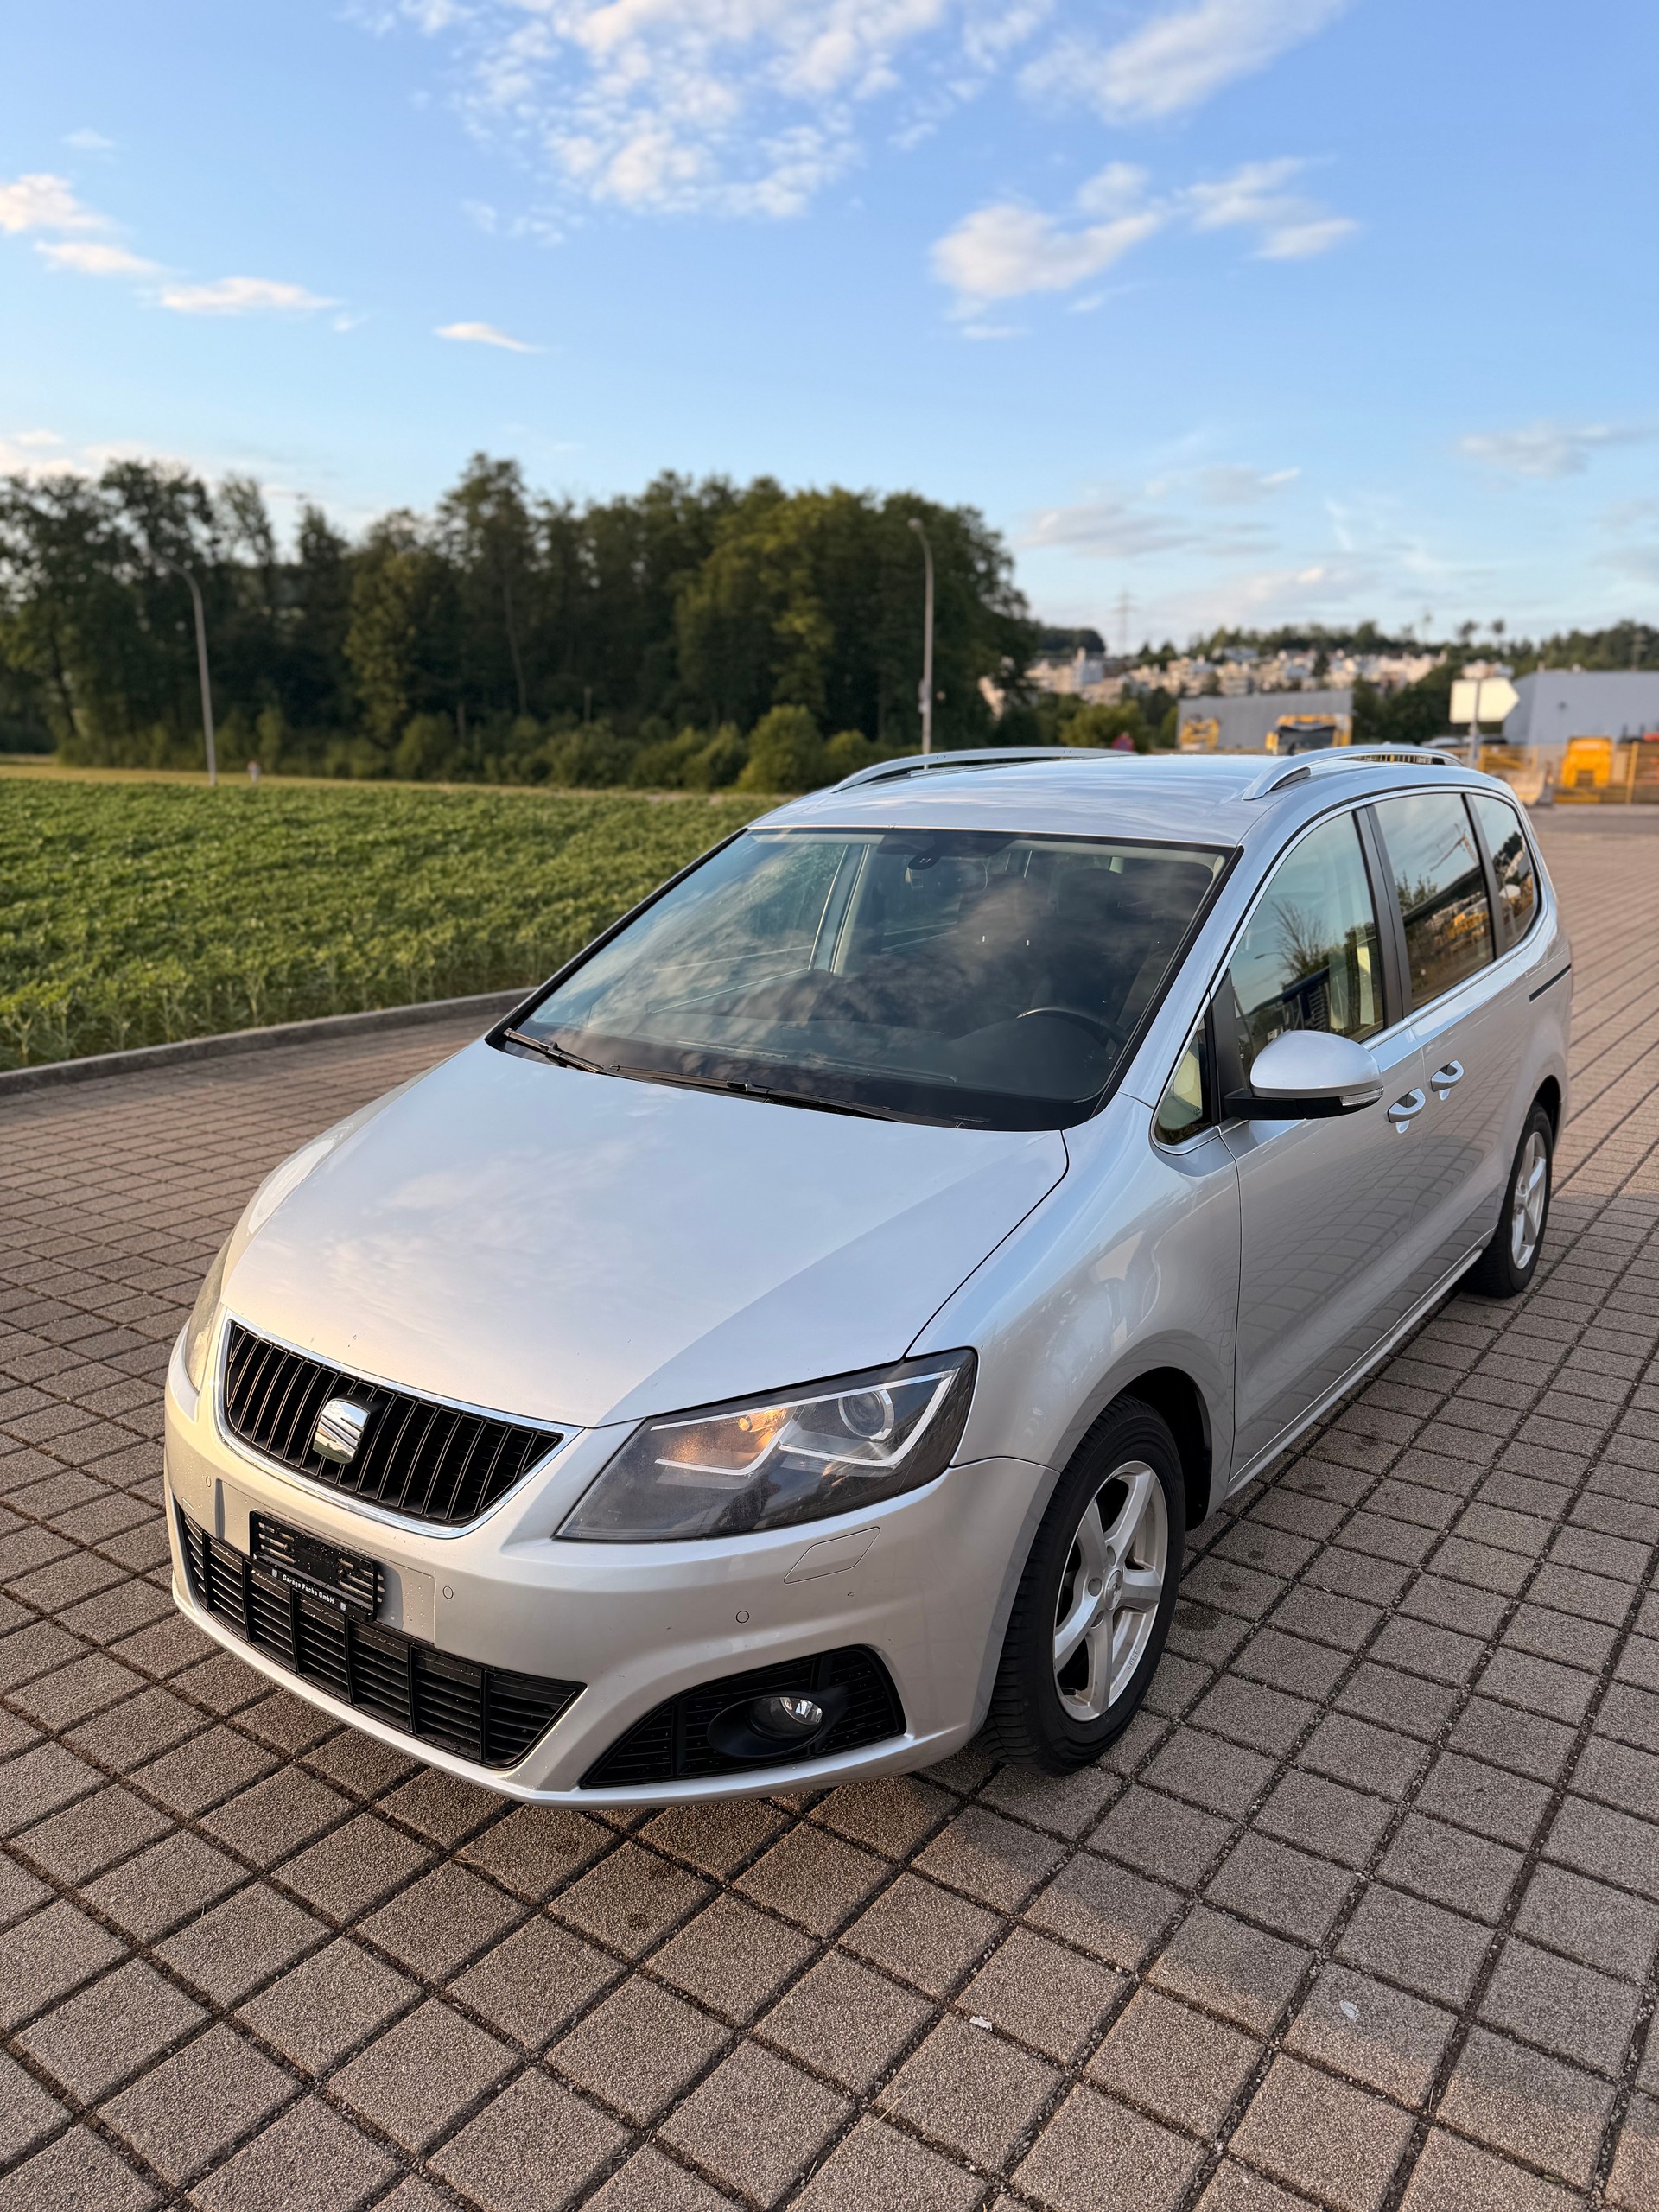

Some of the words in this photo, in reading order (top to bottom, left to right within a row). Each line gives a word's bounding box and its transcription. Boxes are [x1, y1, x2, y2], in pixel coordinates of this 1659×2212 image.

[283, 1574, 301, 1588] Garage
[302, 1583, 317, 1596] Fuchs
[318, 1592, 334, 1604] GmbH
